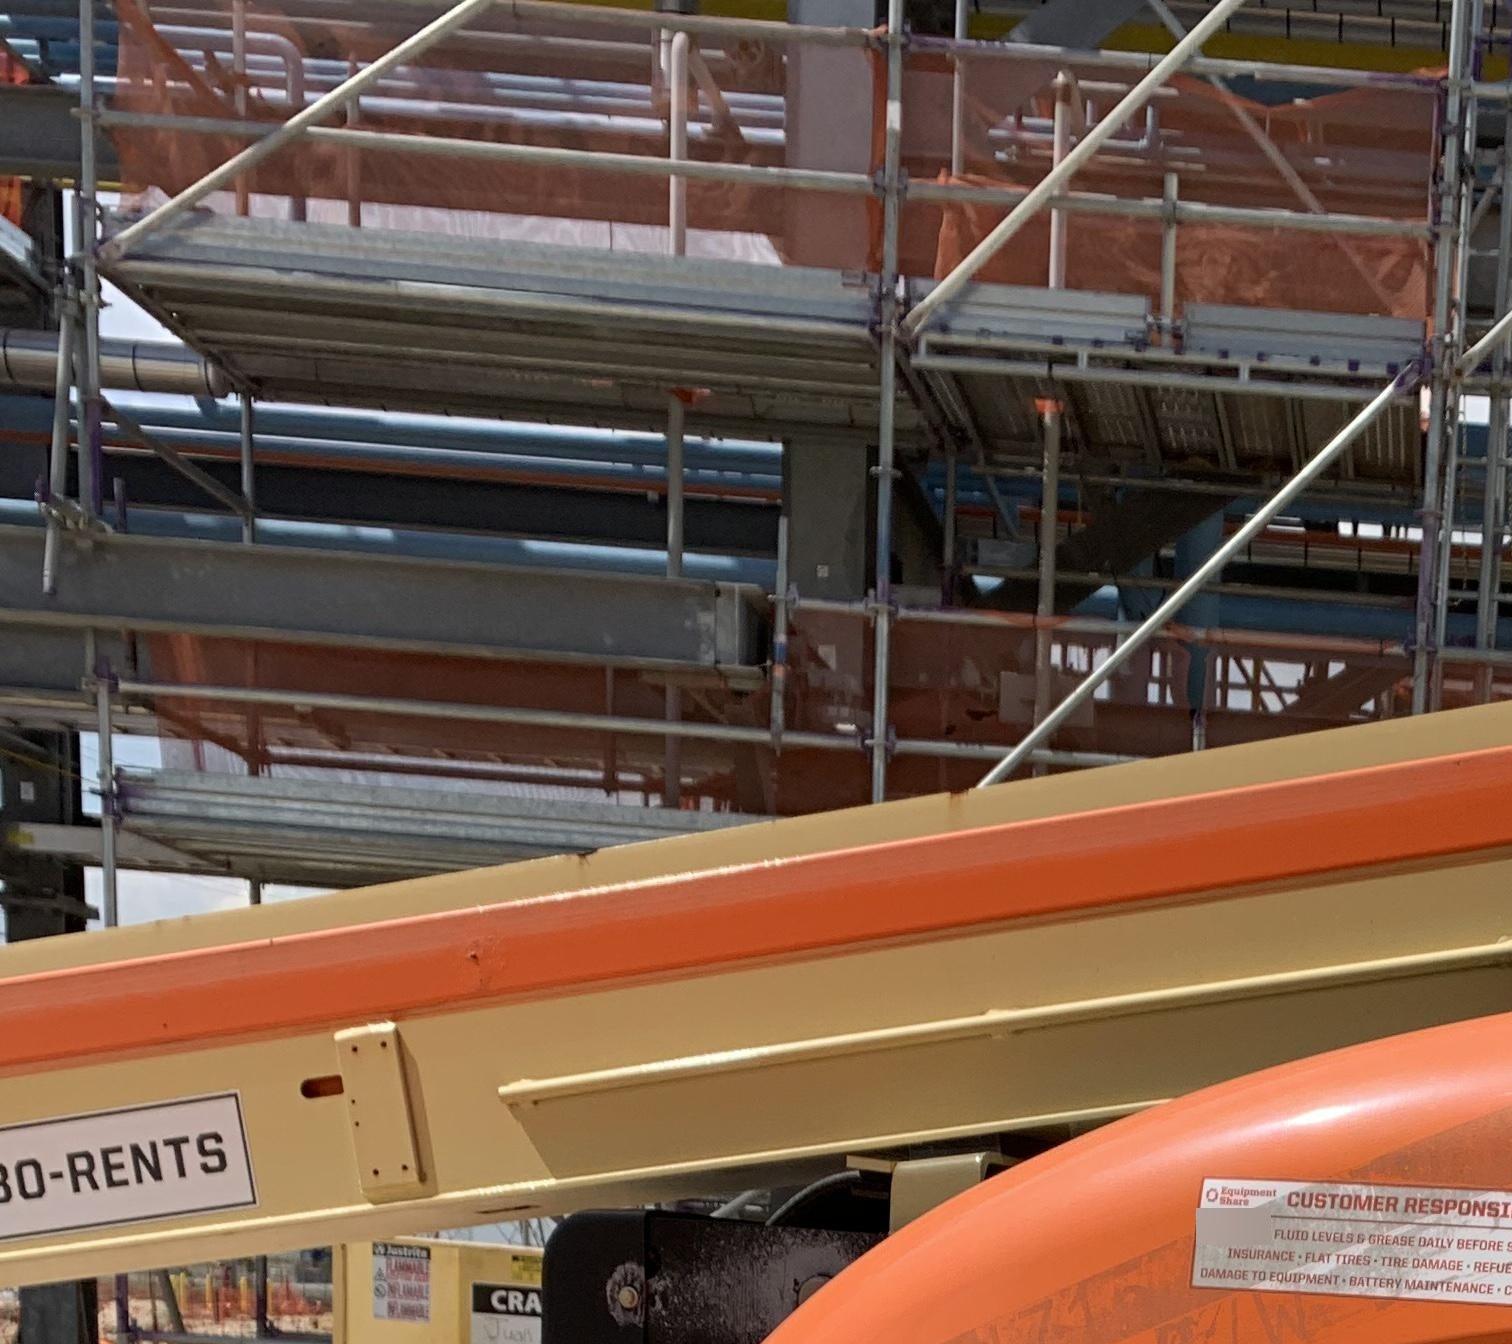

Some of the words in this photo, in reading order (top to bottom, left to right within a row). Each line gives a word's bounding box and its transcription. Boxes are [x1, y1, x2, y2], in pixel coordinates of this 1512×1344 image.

[1220, 1197, 1249, 1206] Share
[1221, 1186, 1276, 1197] Equipment
[1287, 1191, 1399, 1213] CUSTOMER
[1274, 1229, 1308, 1241] FLUID
[1312, 1232, 1353, 1243] LEVELS
[1357, 1235, 1365, 1243] &
[1369, 1234, 1414, 1246] GREASE
[1419, 1237, 1453, 1249] DAILY
[1457, 1239, 1503, 1251] BEFORE
[1228, 1248, 1295, 1261] INSURANCE
[1305, 1253, 1331, 1263] FLAT
[1336, 1254, 1371, 1266] TIRES
[1382, 1256, 1408, 1267] TIRE
[1412, 1258, 1463, 1271] DAMAGE
[1200, 1268, 1249, 1281] DAMAGE
[1252, 1271, 1265, 1281] TO
[1270, 1272, 1340, 1285] EQUIPMENT
[1350, 1276, 1402, 1288] BATTERY
[1404, 1279, 1494, 1294] MAINTENANCE
